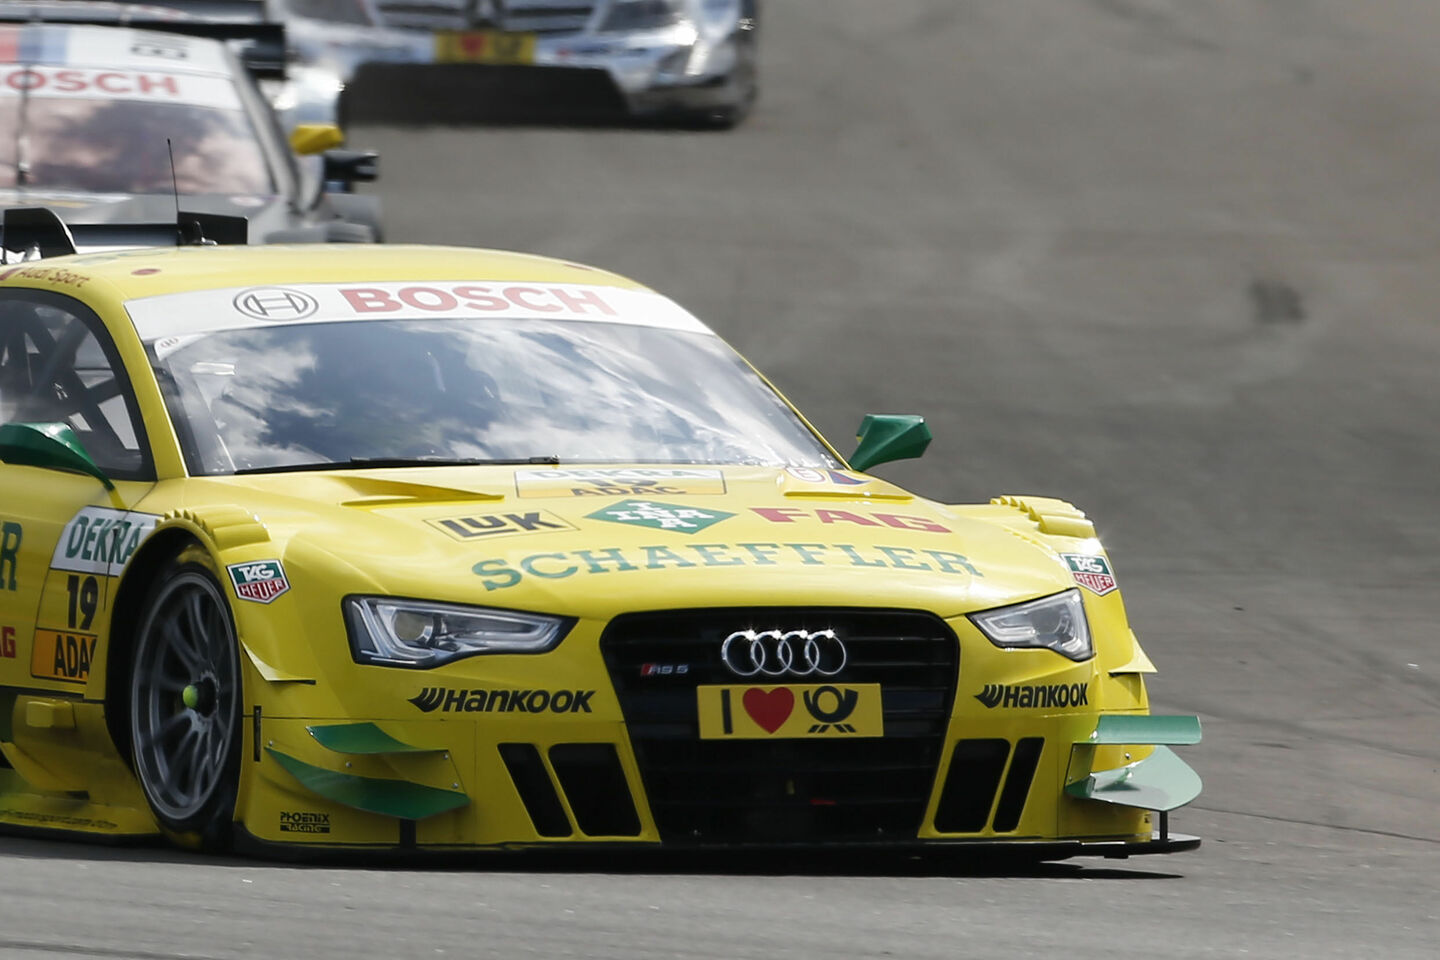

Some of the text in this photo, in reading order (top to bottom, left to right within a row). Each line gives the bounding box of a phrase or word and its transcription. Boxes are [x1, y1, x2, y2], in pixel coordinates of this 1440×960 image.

[47, 268, 90, 288] Sport
[339, 286, 618, 316] BOSCH
[571, 486, 687, 497] ADAC
[748, 506, 953, 534] FAG
[238, 563, 275, 582] TAG
[470, 542, 985, 592] SCHAEFFLER
[1070, 556, 1104, 573] TAG
[240, 579, 284, 600] HEUER
[1074, 572, 1115, 591] HEUER
[67, 574, 98, 631] 19
[280, 811, 330, 824] PHOENIX
